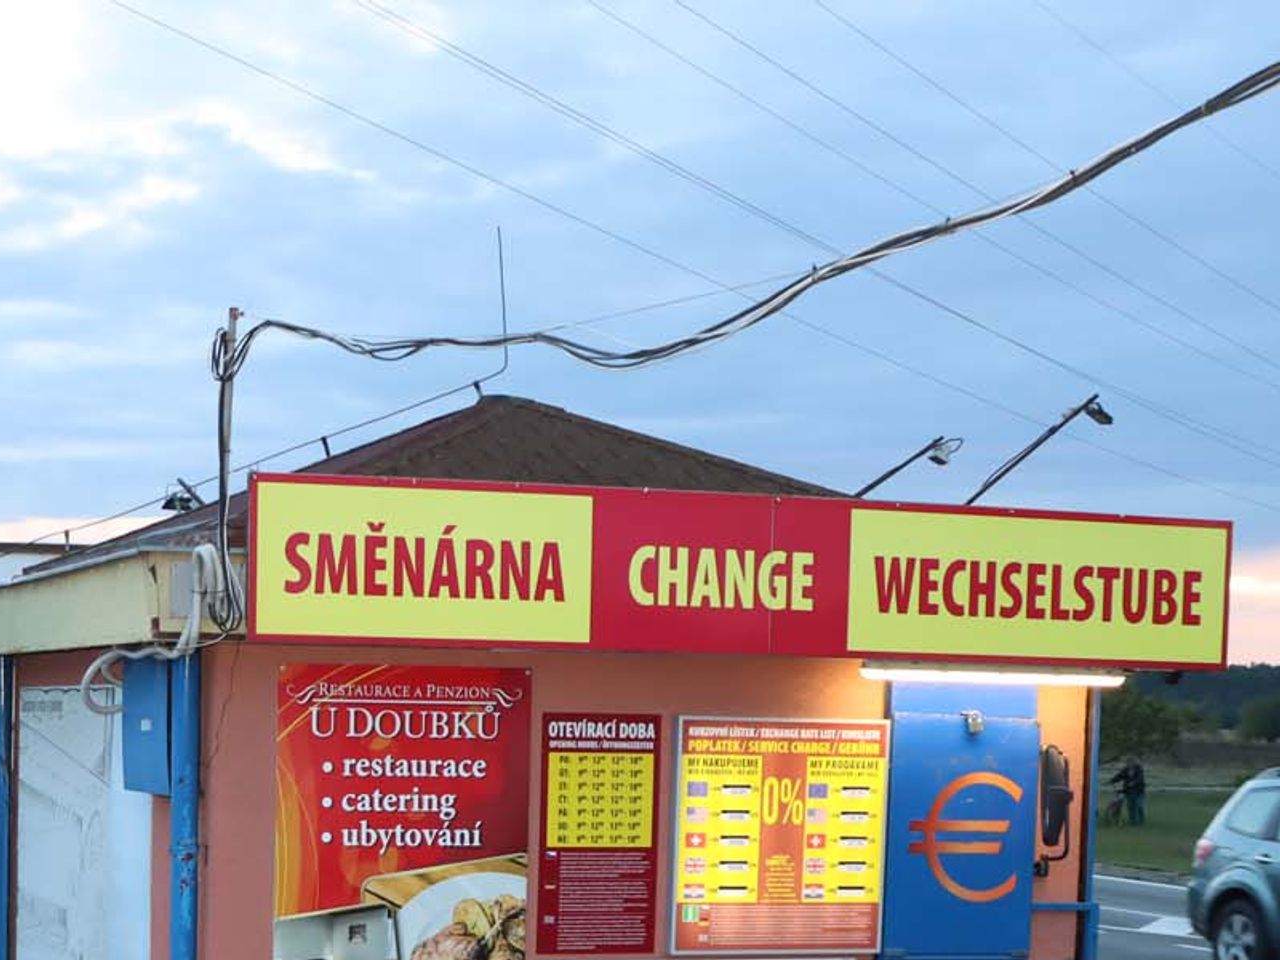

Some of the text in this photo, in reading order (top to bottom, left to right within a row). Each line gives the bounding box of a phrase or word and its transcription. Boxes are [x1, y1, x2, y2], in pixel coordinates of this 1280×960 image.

[284, 522, 1202, 626] SMĚNÁRNA CHANGE WECHSELSTUBE
[320, 682, 410, 697] RESTAURACE
[427, 684, 490, 699] PENZION
[310, 704, 500, 740] U DOUBKŮ
[549, 719, 655, 739] OTEVÍRACÍ DOBA
[342, 755, 486, 778] restaurace
[342, 788, 456, 820] catering
[762, 776, 803, 826] 0%
[342, 821, 482, 854] ubytování
